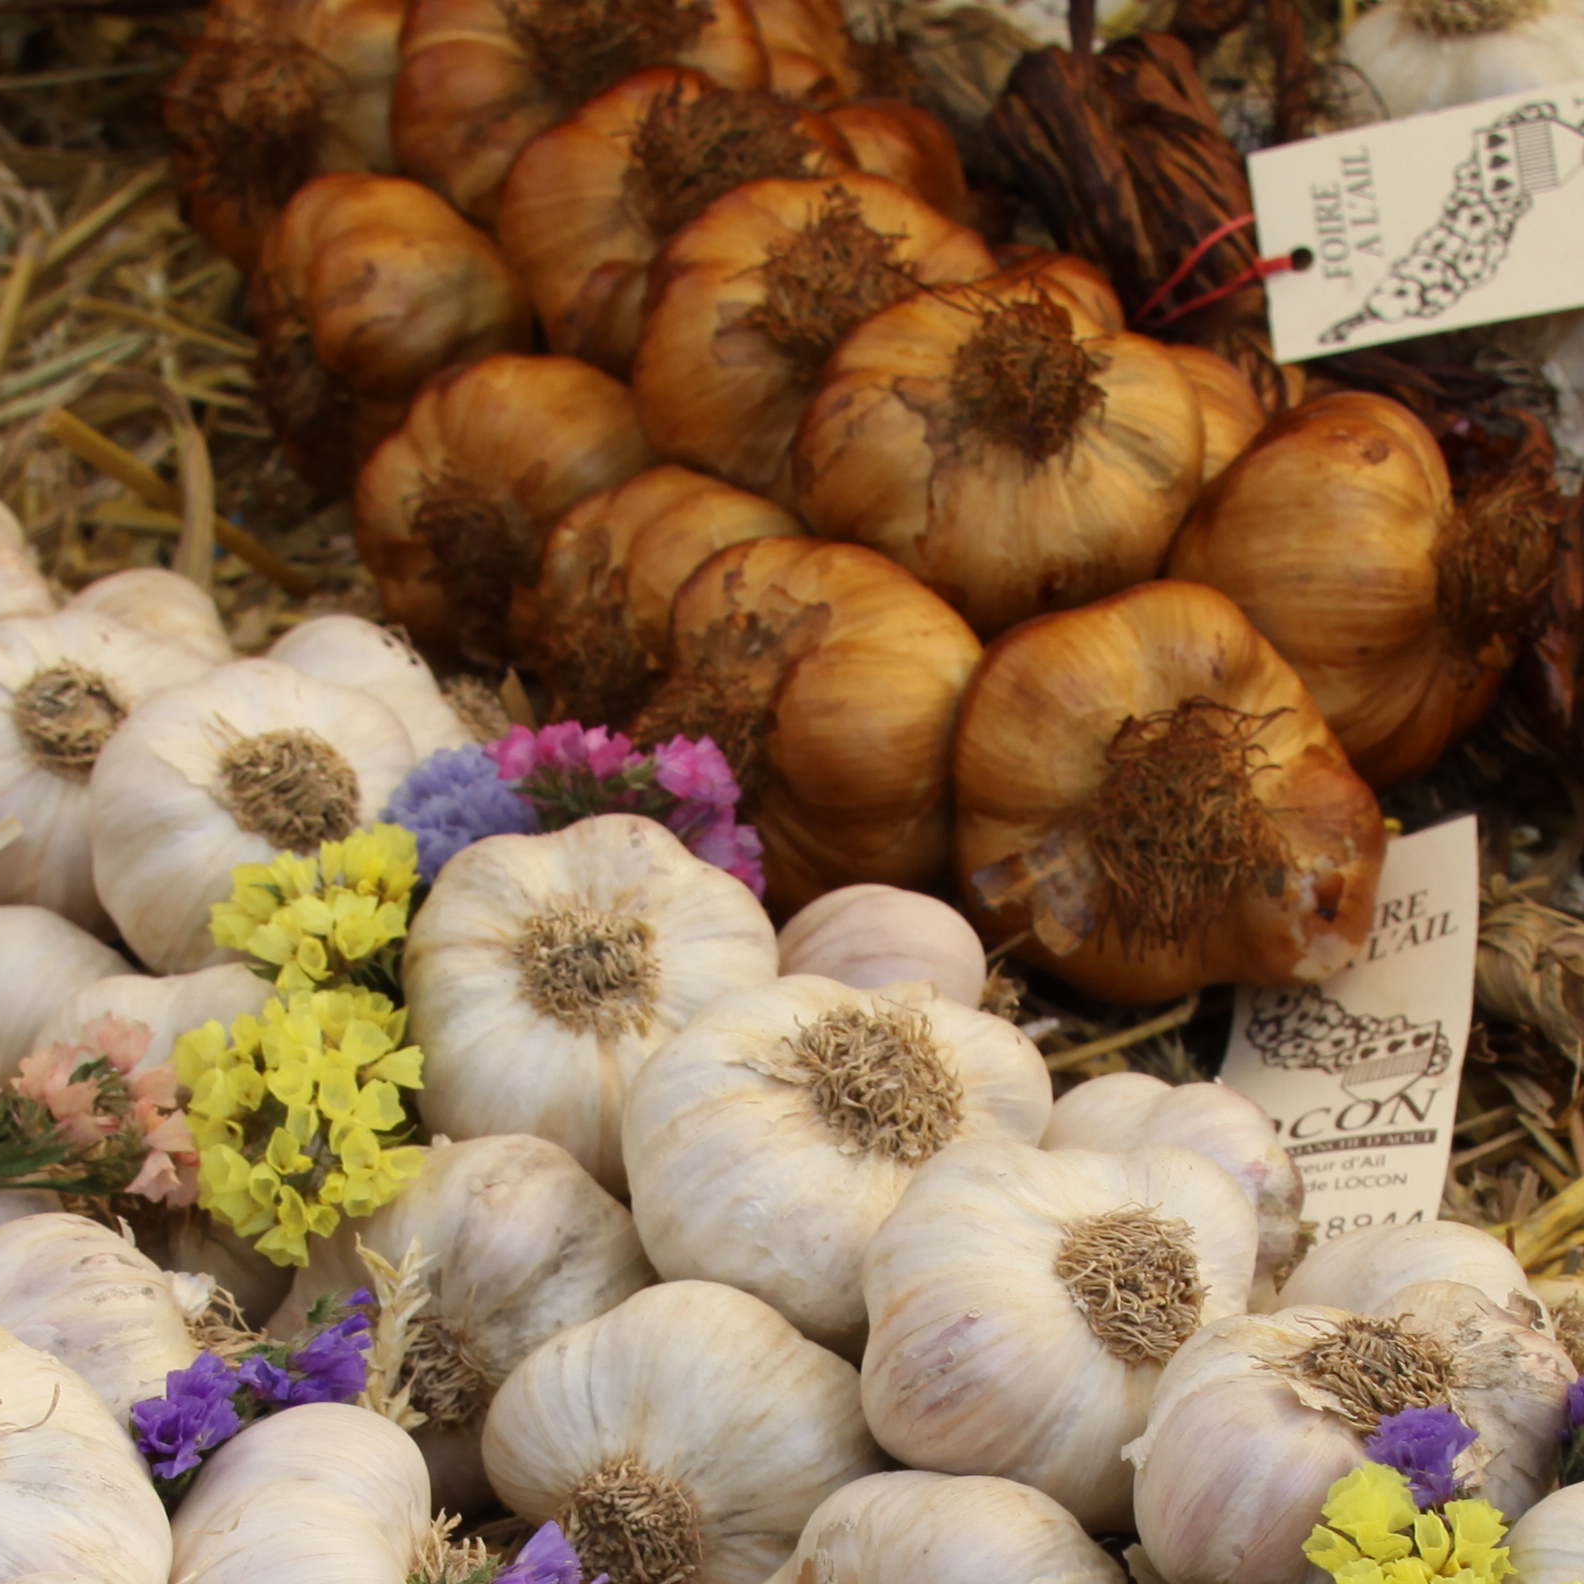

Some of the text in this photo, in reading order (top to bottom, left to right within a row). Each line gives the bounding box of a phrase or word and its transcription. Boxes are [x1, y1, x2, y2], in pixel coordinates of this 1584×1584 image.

[1340, 145, 1385, 258] A L'AIL
[1311, 181, 1353, 280] FOIRE
[1271, 1087, 1443, 1139] CON
[1334, 1173, 1408, 1191] LOCON
[1342, 1154, 1386, 1172] d'Ail
